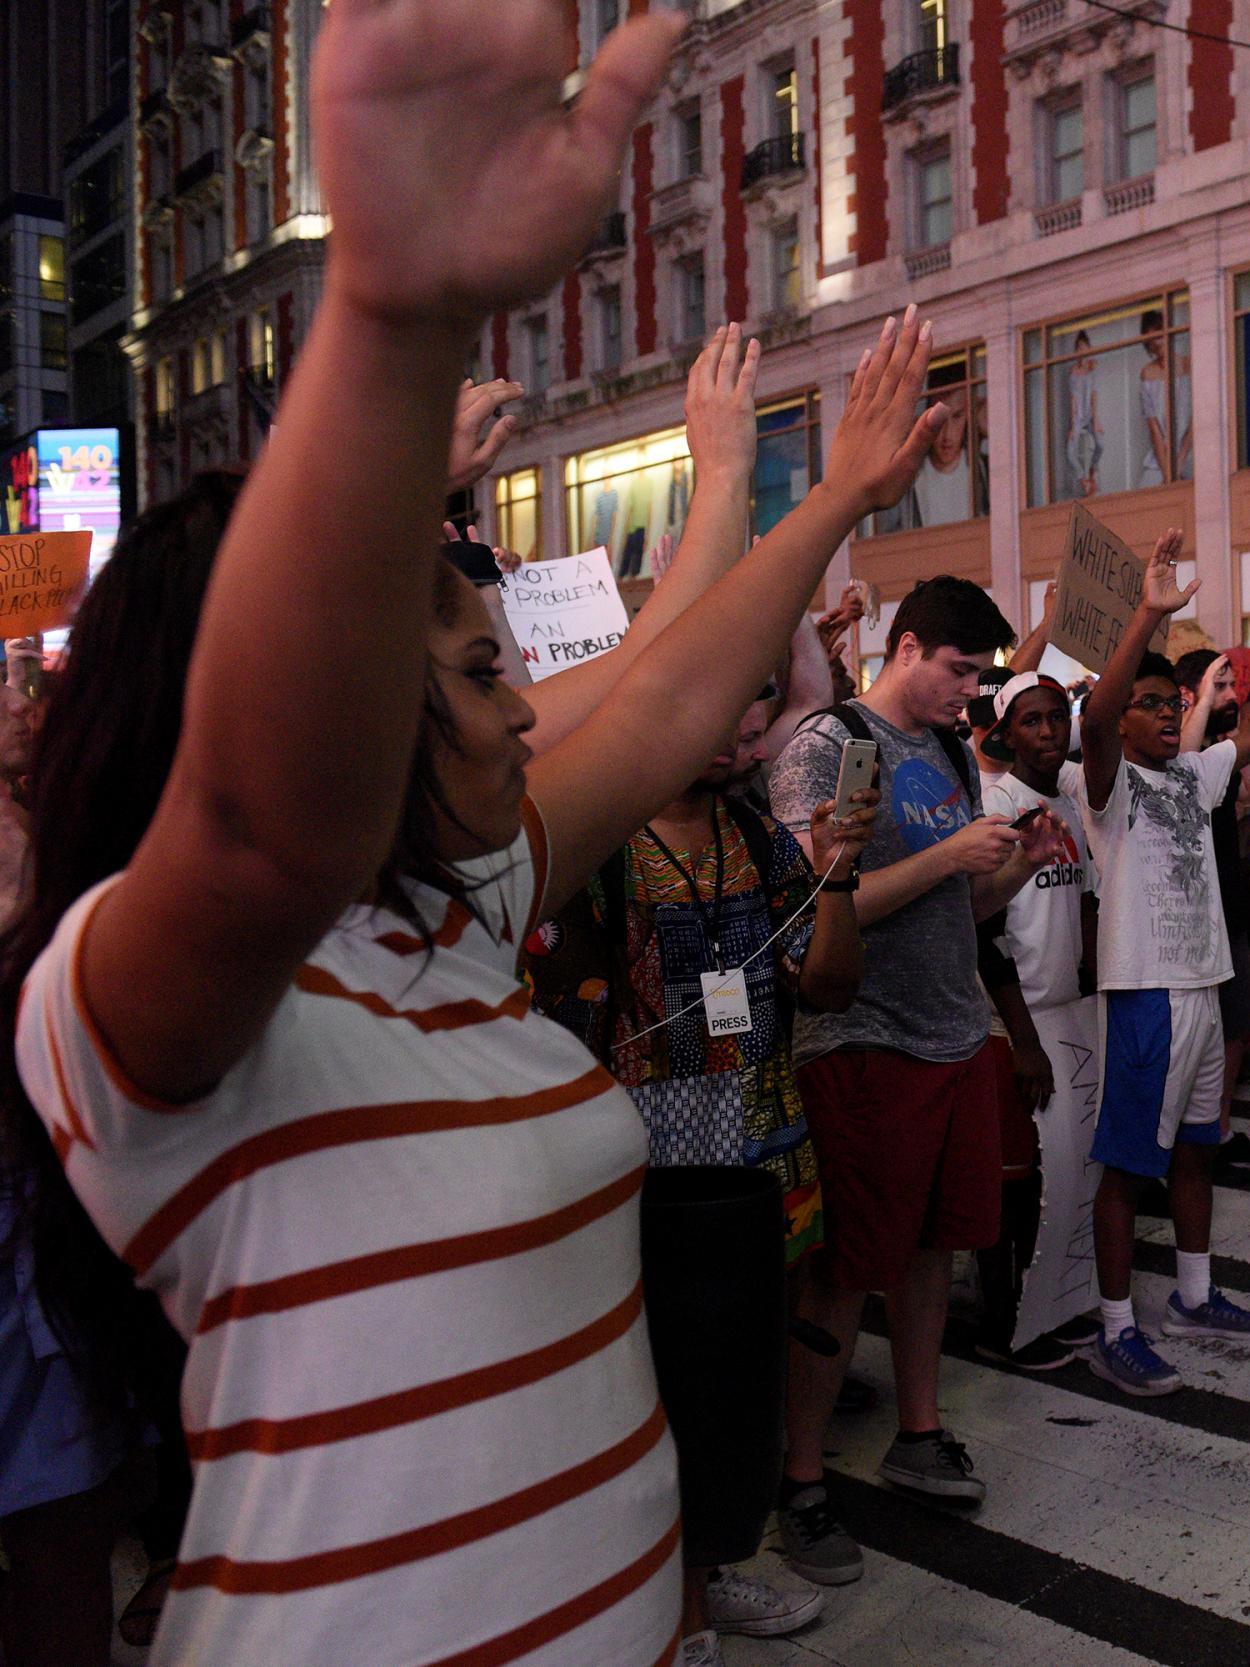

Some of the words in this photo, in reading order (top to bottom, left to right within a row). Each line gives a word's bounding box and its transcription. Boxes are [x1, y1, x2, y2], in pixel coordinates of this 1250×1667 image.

[58, 445, 112, 471] 140
[0, 538, 45, 571] STOP
[1072, 517, 1118, 592] WHITE
[0, 564, 62, 596] ILLING
[511, 565, 559, 584] NOT
[576, 561, 593, 578] A
[0, 591, 42, 616] LACK
[515, 580, 610, 607] PROBLEM
[530, 621, 566, 640] AN
[1061, 587, 1107, 653] WHITE
[902, 801, 970, 829] NASA
[712, 1016, 748, 1031] PRESS
